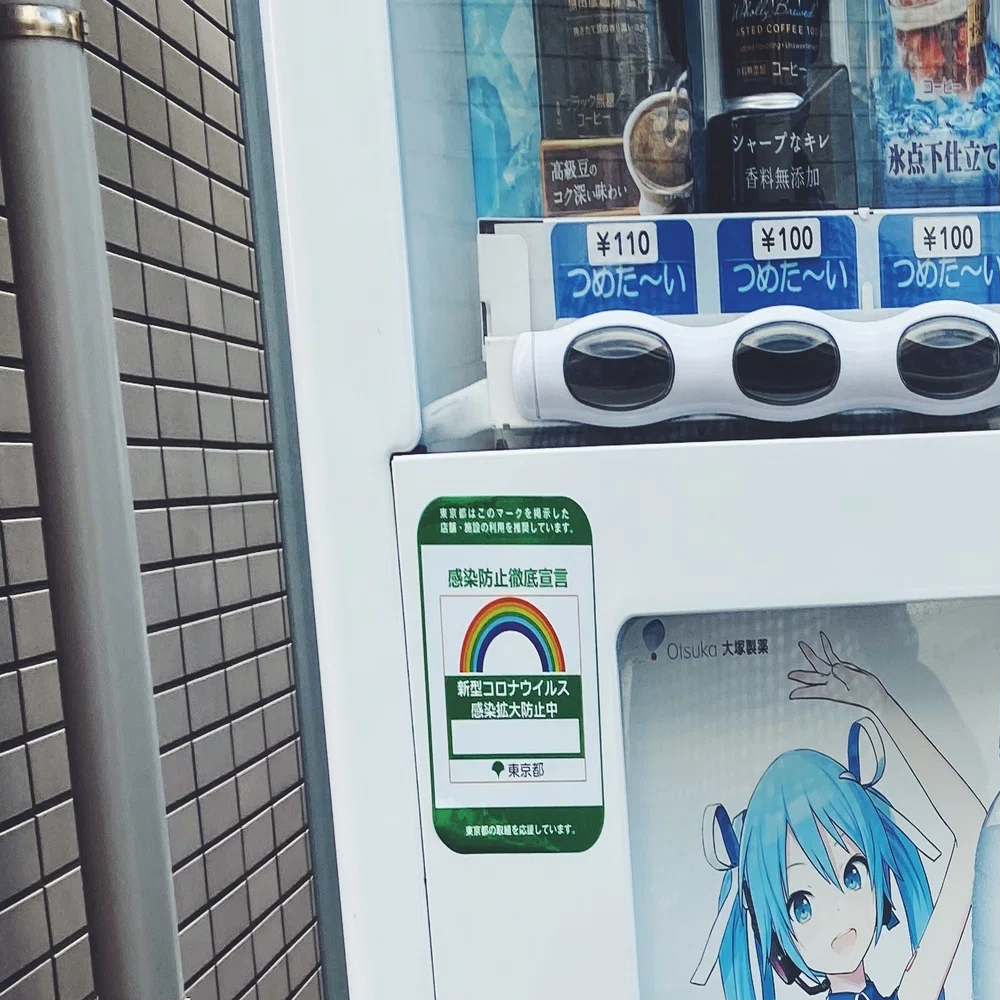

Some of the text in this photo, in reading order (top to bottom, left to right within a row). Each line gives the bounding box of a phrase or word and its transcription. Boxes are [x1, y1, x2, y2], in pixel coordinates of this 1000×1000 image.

[766, 24, 803, 35] COFFEE
[772, 61, 807, 76] コーヒー
[732, 130, 830, 155] シャープなキレ
[888, 139, 998, 176] 氷点下仕立て
[550, 157, 598, 182] 高級豆の
[744, 165, 820, 190] 香料無添加
[553, 181, 628, 207] コク深い味わい
[597, 230, 650, 256] ¥110
[762, 225, 813, 253] ¥100
[923, 224, 974, 252] ¥100
[439, 507, 570, 520] 東京都はこのマークを掲示した
[448, 568, 568, 589] 感染防止徹底宣言
[667, 638, 769, 661] Otsuka 大塚製薬
[457, 680, 570, 697] 新型コロナウイルス
[471, 701, 558, 719] 感染拡大防止中
[508, 762, 545, 778] 東京都
[465, 824, 576, 837] 東京都の取組を応援しています。
